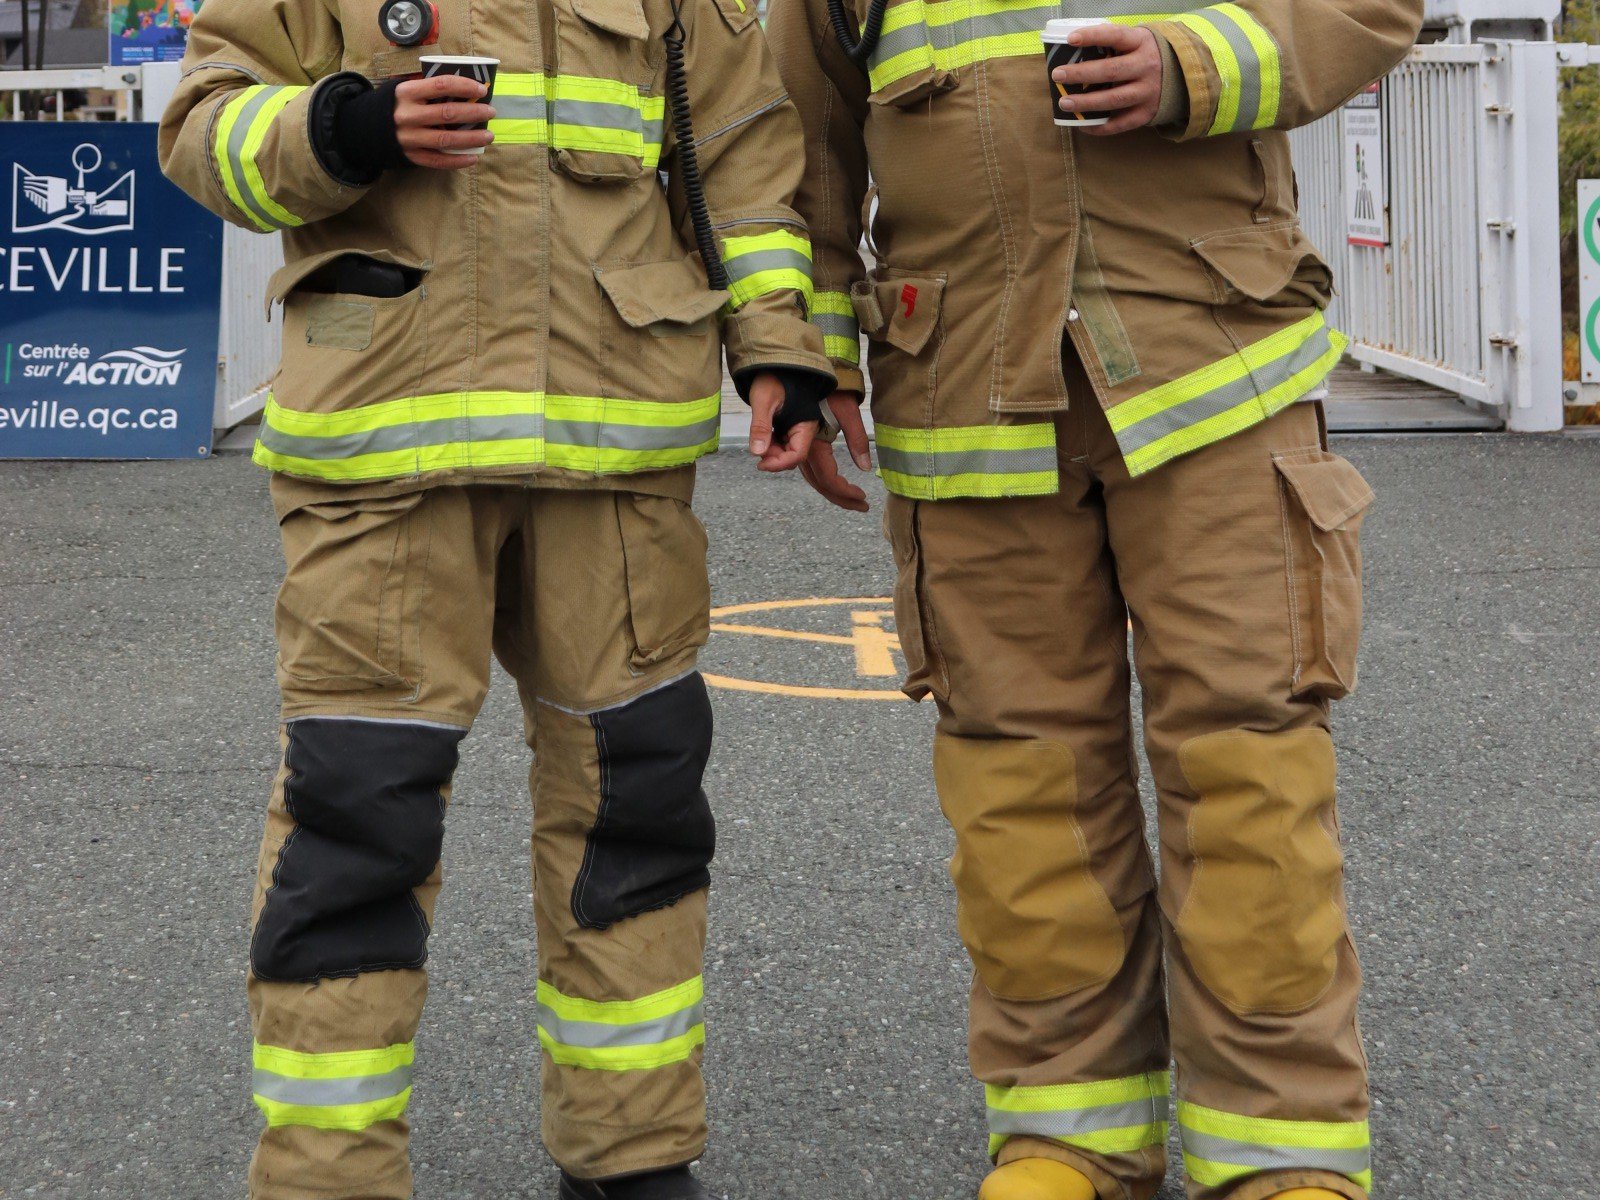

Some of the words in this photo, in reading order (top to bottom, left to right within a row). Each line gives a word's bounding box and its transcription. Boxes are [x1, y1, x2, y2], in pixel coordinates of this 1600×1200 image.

[0, 246, 186, 292] EVILLE
[18, 342, 91, 359] Centrée
[23, 364, 54, 377] sur
